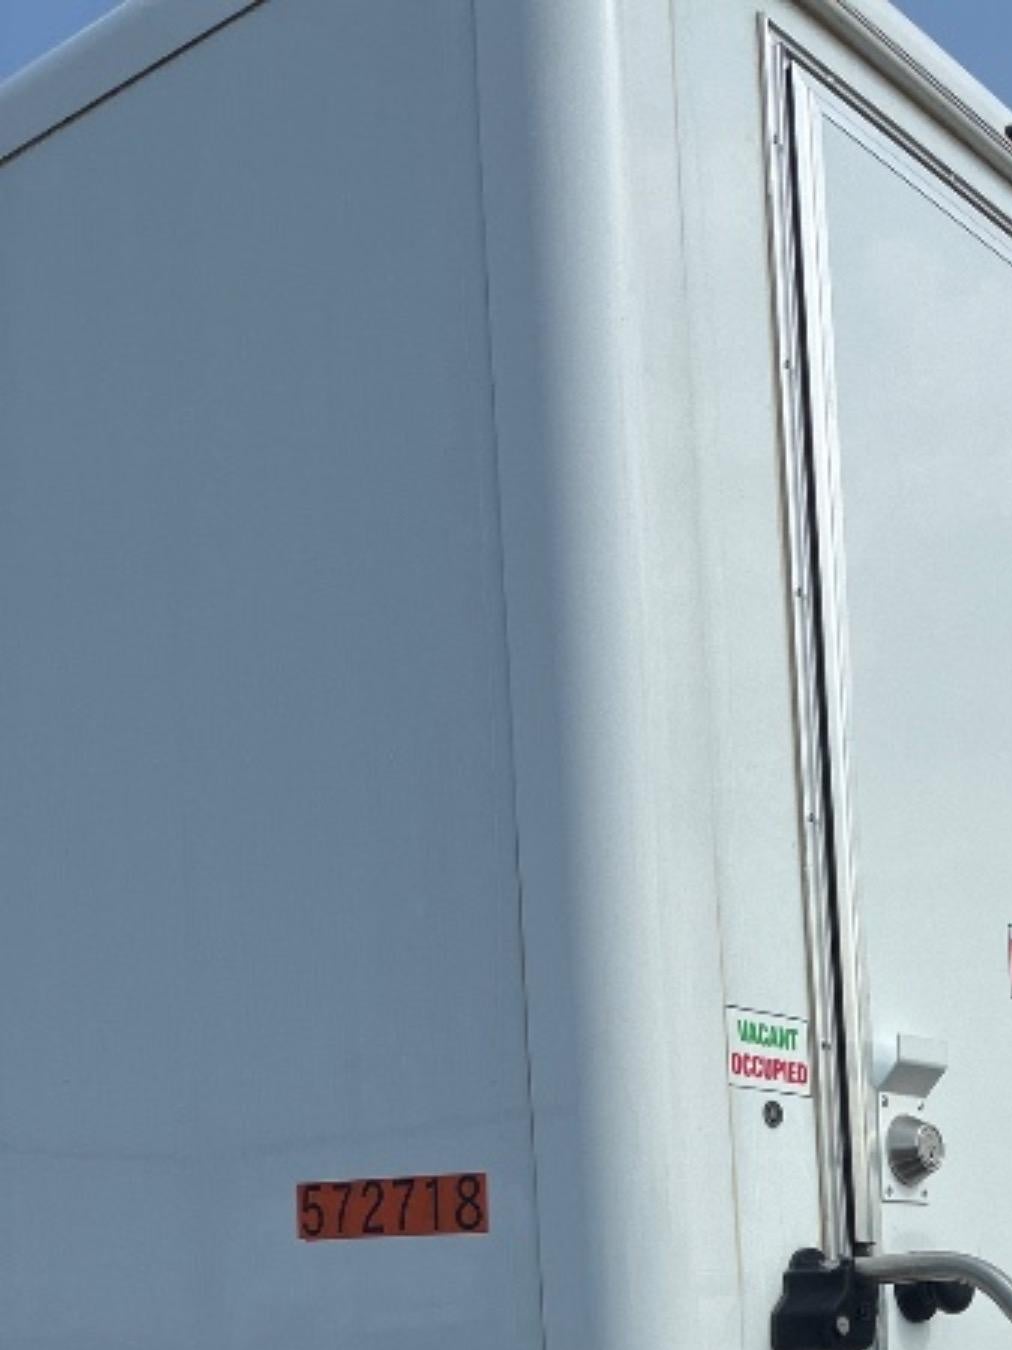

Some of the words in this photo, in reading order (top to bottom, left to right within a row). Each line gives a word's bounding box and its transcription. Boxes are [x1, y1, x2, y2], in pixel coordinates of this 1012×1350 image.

[737, 1019, 798, 1051] VACANT
[731, 1052, 808, 1085] OCCUPIED
[302, 1174, 483, 1237] 572718
